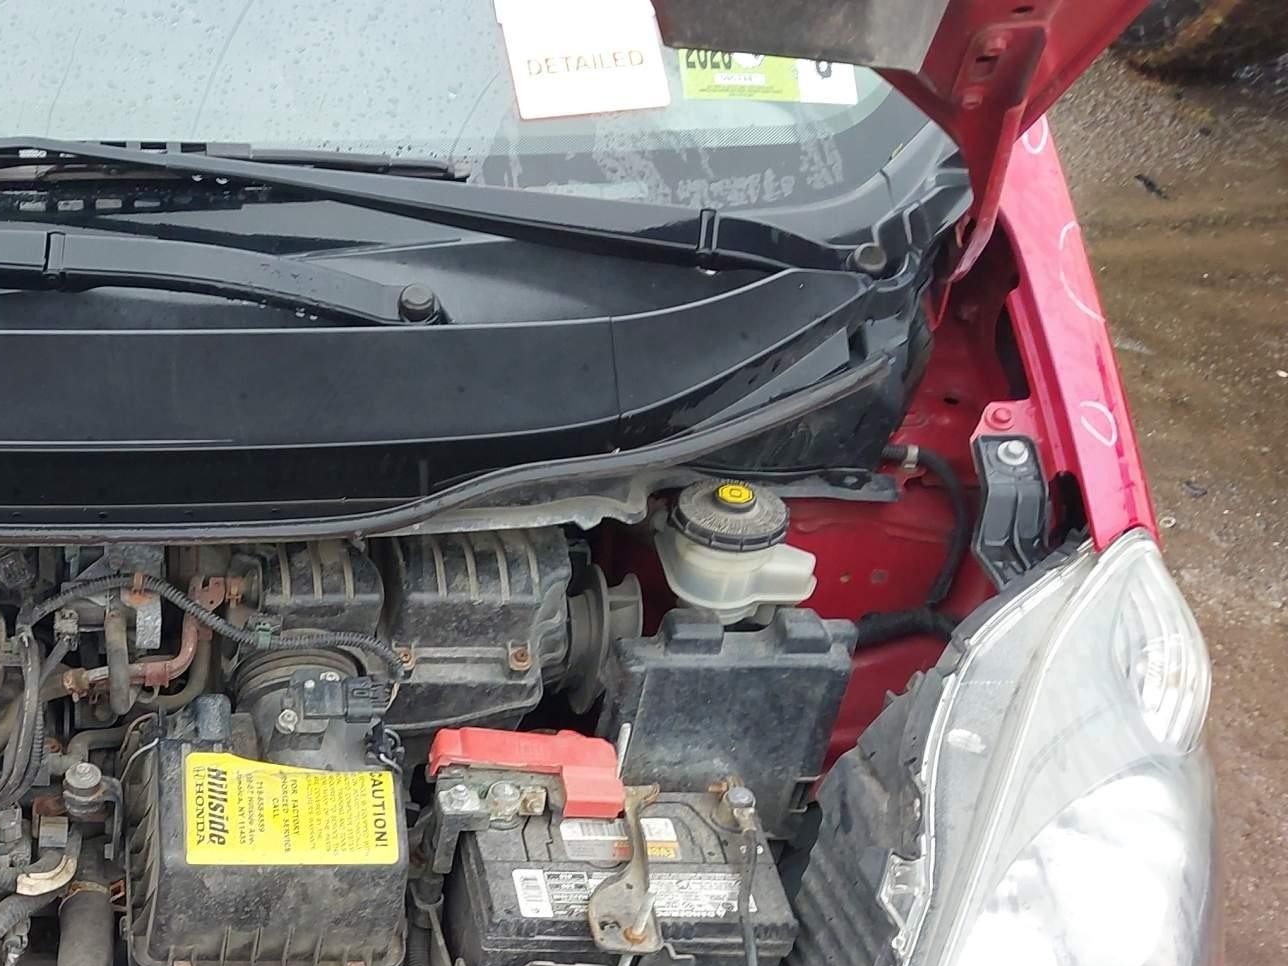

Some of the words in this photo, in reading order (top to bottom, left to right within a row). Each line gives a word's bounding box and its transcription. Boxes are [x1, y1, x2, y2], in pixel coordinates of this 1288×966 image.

[526, 50, 644, 76] DETAILED
[195, 783, 205, 846] HONDA
[207, 767, 229, 845] Hillside
[238, 806, 246, 819] NY
[272, 797, 280, 819] CALL
